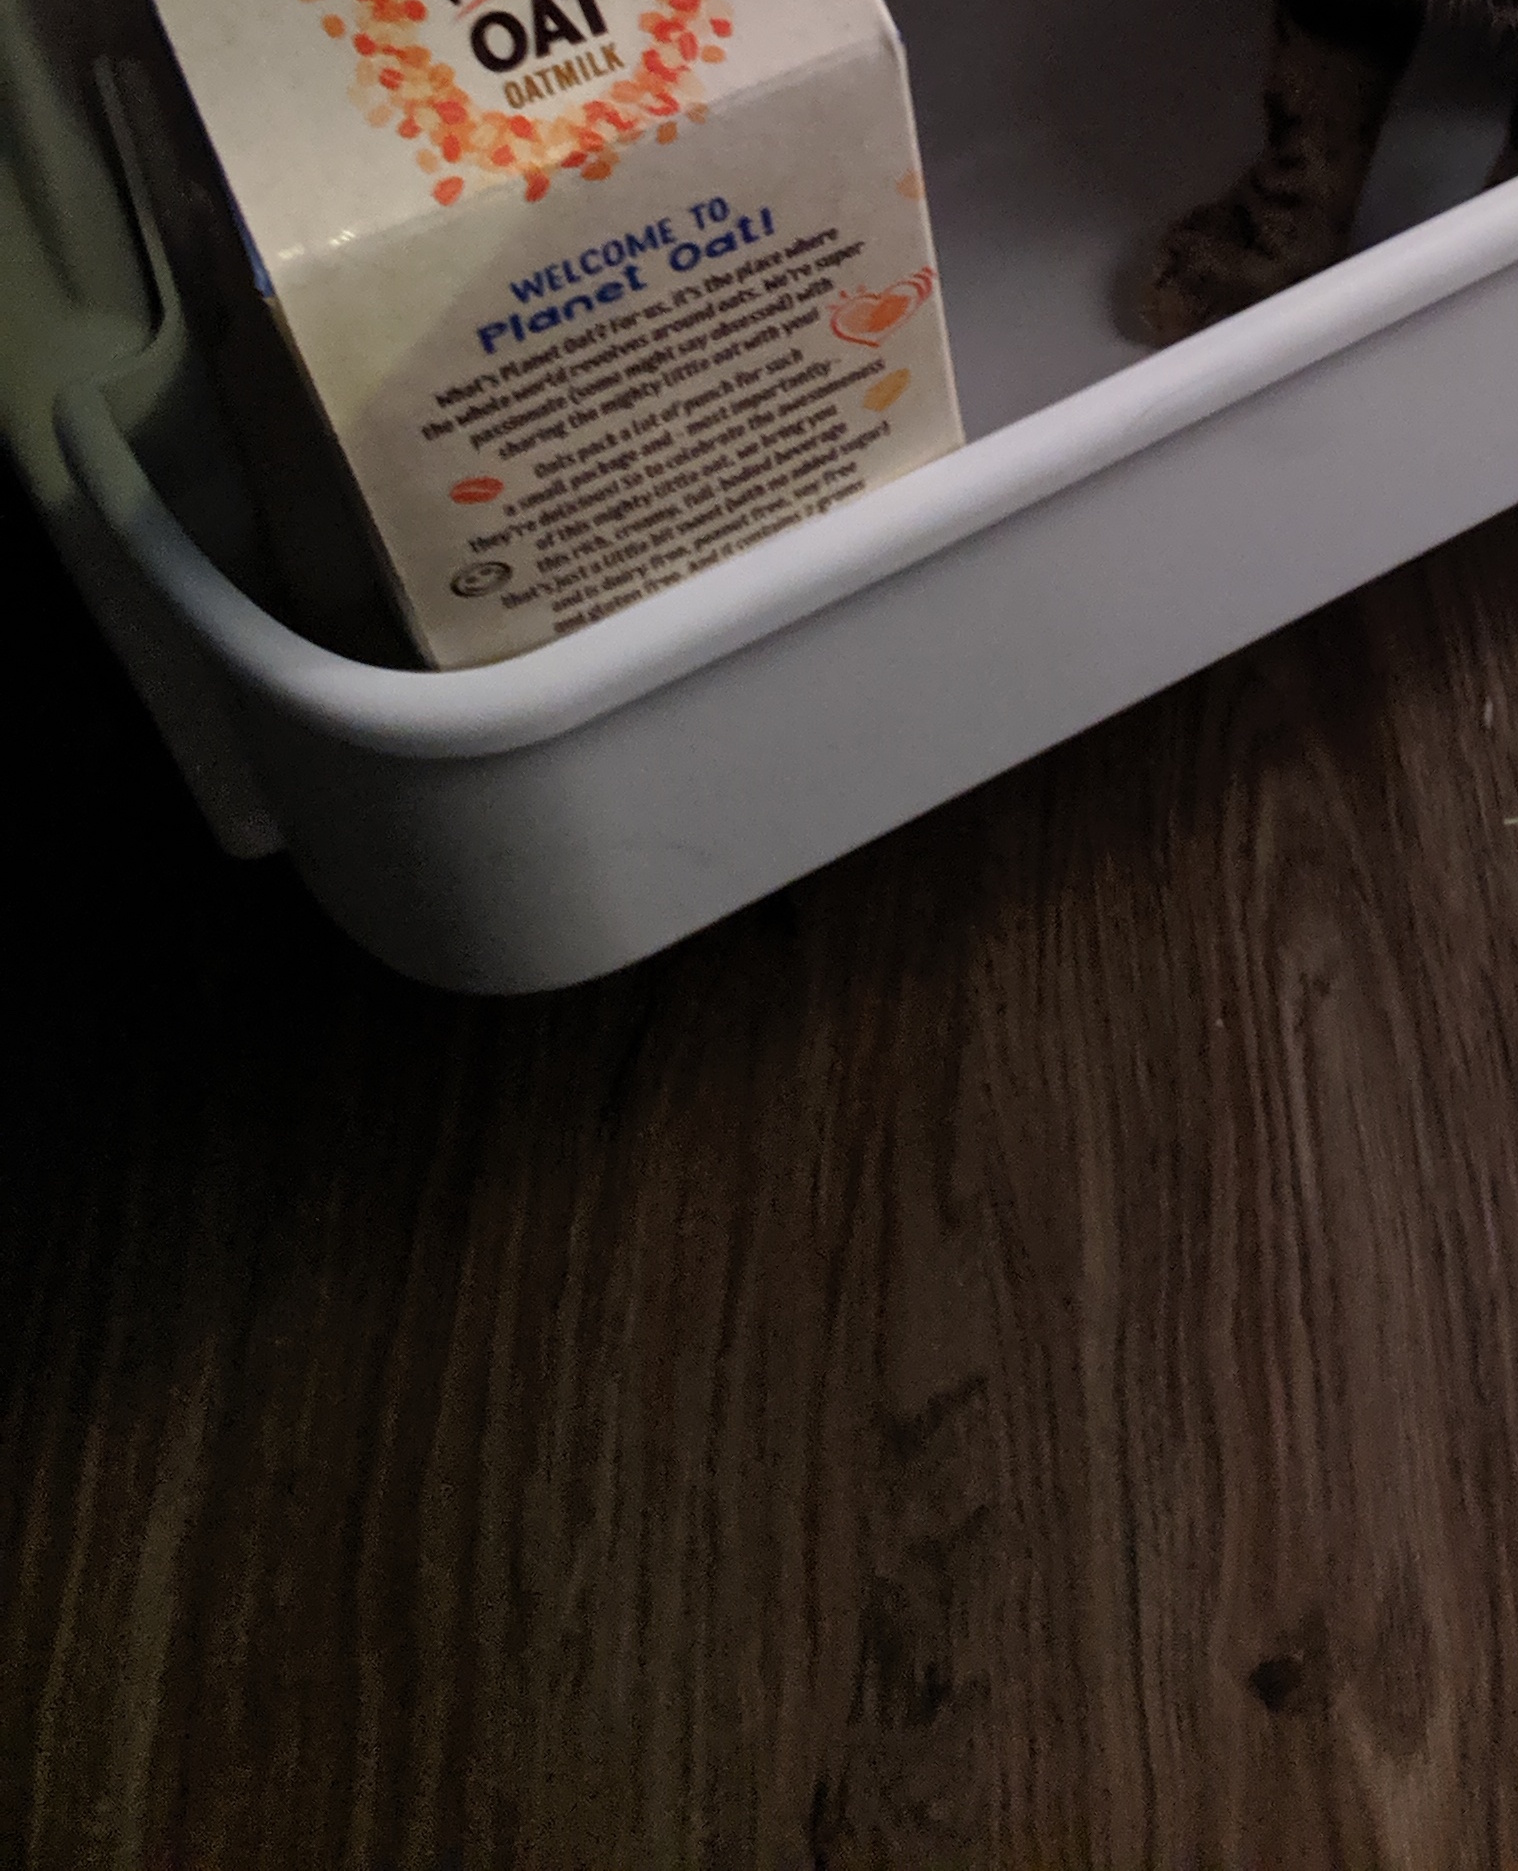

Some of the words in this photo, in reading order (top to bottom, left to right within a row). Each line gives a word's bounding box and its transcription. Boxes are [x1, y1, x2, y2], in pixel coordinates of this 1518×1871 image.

[503, 41, 627, 110] OATMILK
[475, 263, 647, 355] Planet
[664, 206, 774, 272] Oat!
[508, 217, 677, 304] WELCOME
[687, 196, 730, 231] TO
[702, 272, 734, 293] the
[734, 250, 782, 284] place
[783, 227, 838, 259] where
[454, 395, 511, 427] whole
[511, 365, 570, 402] world
[568, 333, 650, 377] revolves
[650, 301, 716, 342] around
[813, 240, 865, 271] super
[468, 395, 567, 451] passionate
[623, 345, 676, 379] might
[676, 332, 708, 356] say
[795, 277, 834, 303] with
[497, 419, 569, 461] sharing
[567, 407, 599, 429] the
[598, 379, 663, 415] mighty
[660, 357, 711, 388] little
[711, 341, 742, 365] oat
[740, 325, 780, 351] with
[516, 477, 568, 511] small
[569, 449, 639, 491] package
[639, 429, 674, 457] and
[685, 405, 730, 436] most
[729, 359, 831, 415] importantly
[575, 431, 618, 463] pack
[630, 412, 661, 436] lot
[680, 379, 734, 417] punch
[733, 367, 763, 388] for
[764, 347, 803, 375] such
[664, 424, 746, 469] celebrate
[746, 410, 775, 431] the
[776, 358, 885, 418] awesomeness
[773, 421, 847, 465] beverage
[555, 519, 591, 542] this
[591, 491, 653, 527] mighty
[652, 470, 700, 499] little
[759, 417, 806, 448] bring
[805, 403, 838, 429] you
